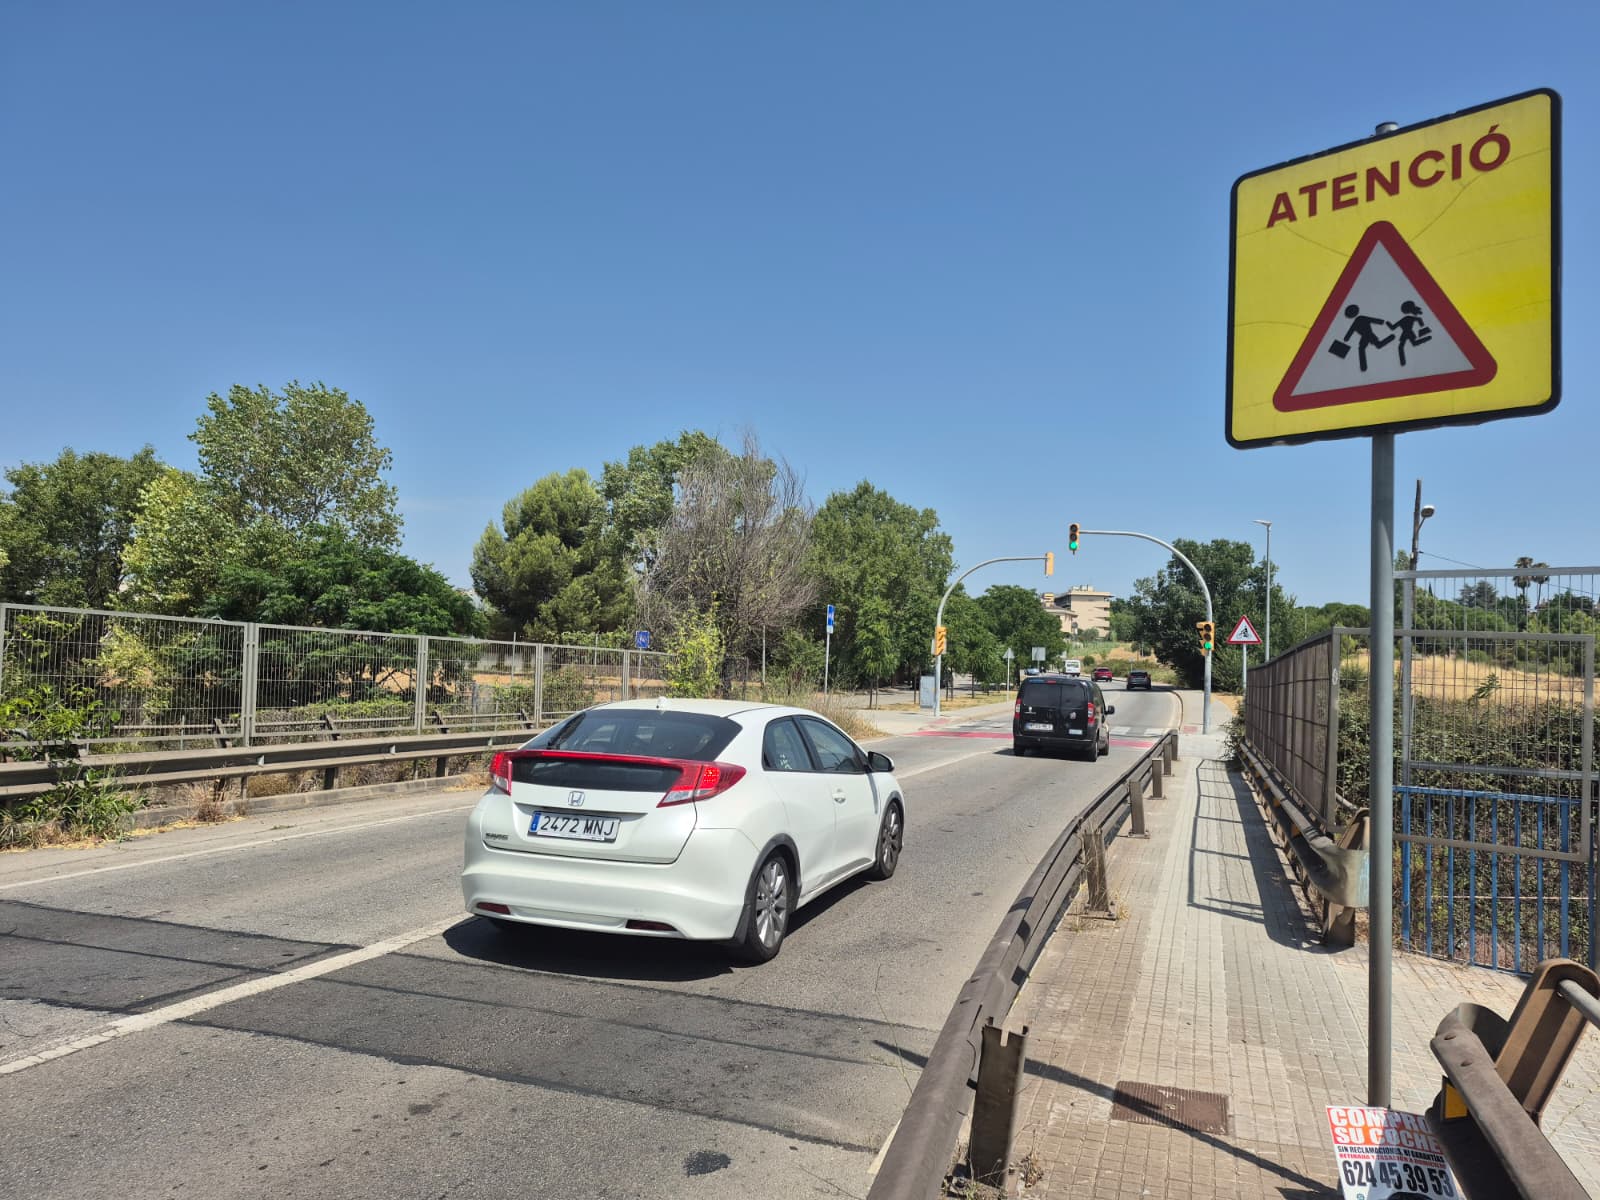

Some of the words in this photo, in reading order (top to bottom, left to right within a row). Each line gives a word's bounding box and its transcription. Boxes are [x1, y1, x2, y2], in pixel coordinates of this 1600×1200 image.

[1266, 124, 1511, 228] ATENCIÓ
[540, 815, 580, 834] 2472
[583, 819, 616, 837] MNJ
[1329, 1107, 1431, 1133] COMPRO
[1334, 1127, 1365, 1145] SU
[1368, 1127, 1442, 1152] COCHE
[1342, 1160, 1377, 1188] 624
[1379, 1162, 1403, 1190] 45
[1402, 1163, 1429, 1194] 39
[1427, 1167, 1455, 1198] 53
